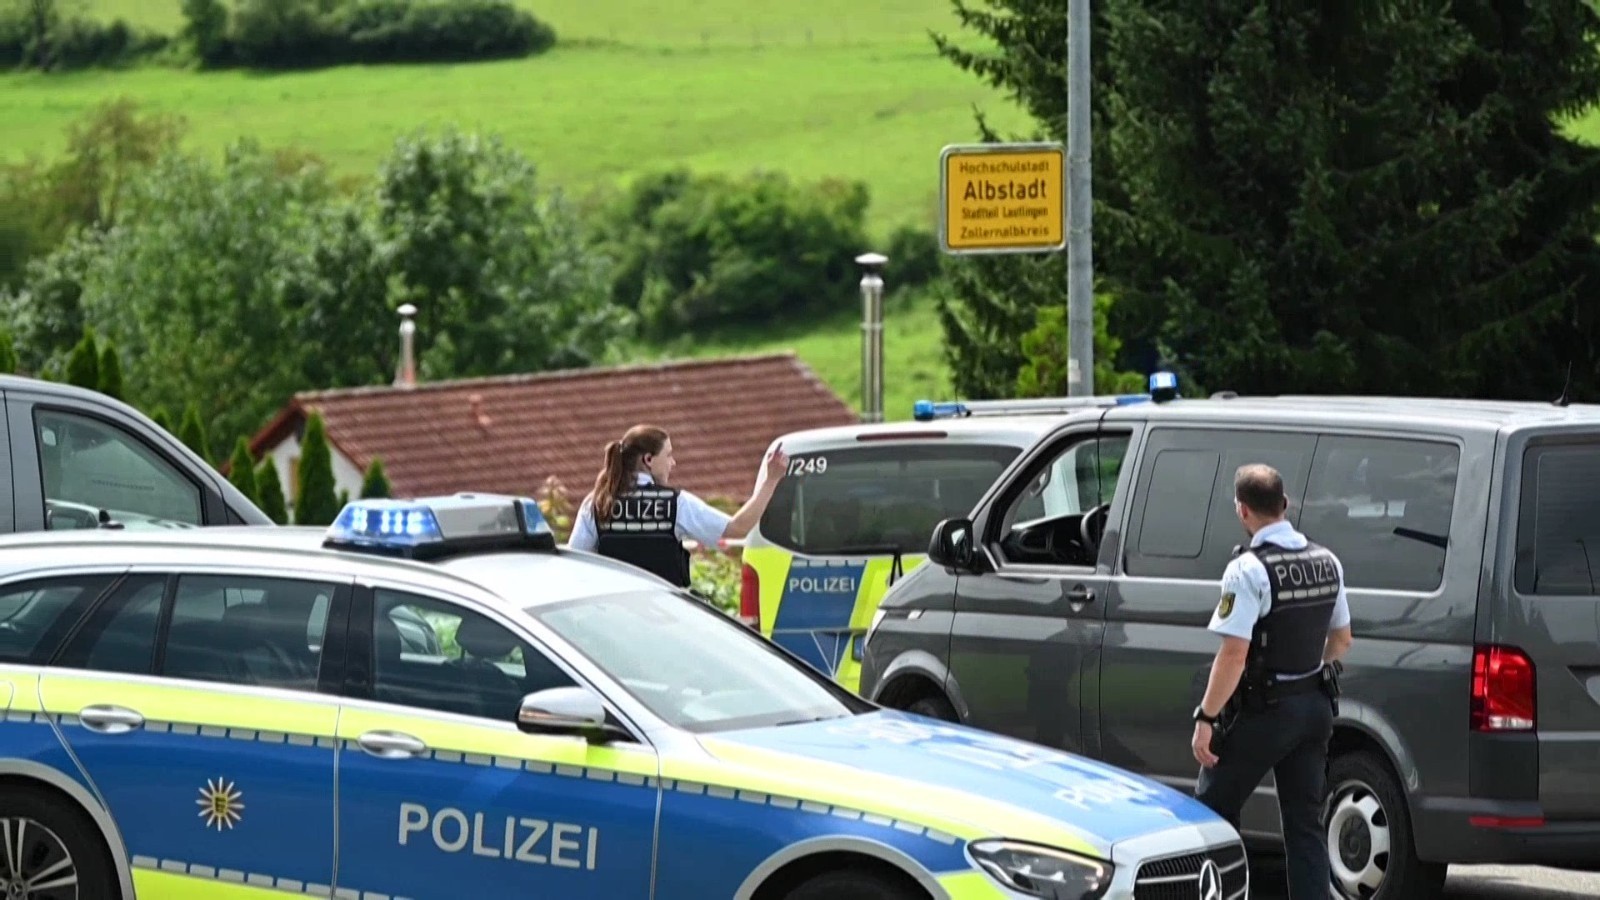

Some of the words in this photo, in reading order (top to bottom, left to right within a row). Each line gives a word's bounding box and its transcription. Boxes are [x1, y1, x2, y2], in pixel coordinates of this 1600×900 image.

[960, 161, 1049, 174] Hochschulstadt
[964, 178, 1046, 200] Albstadt
[961, 226, 1049, 239] Zollernalbkreis
[611, 500, 671, 519] OLIZEI
[1275, 559, 1337, 586] POLIZEI
[789, 577, 855, 593] POLIZEI
[398, 802, 598, 870] POLIZEI
